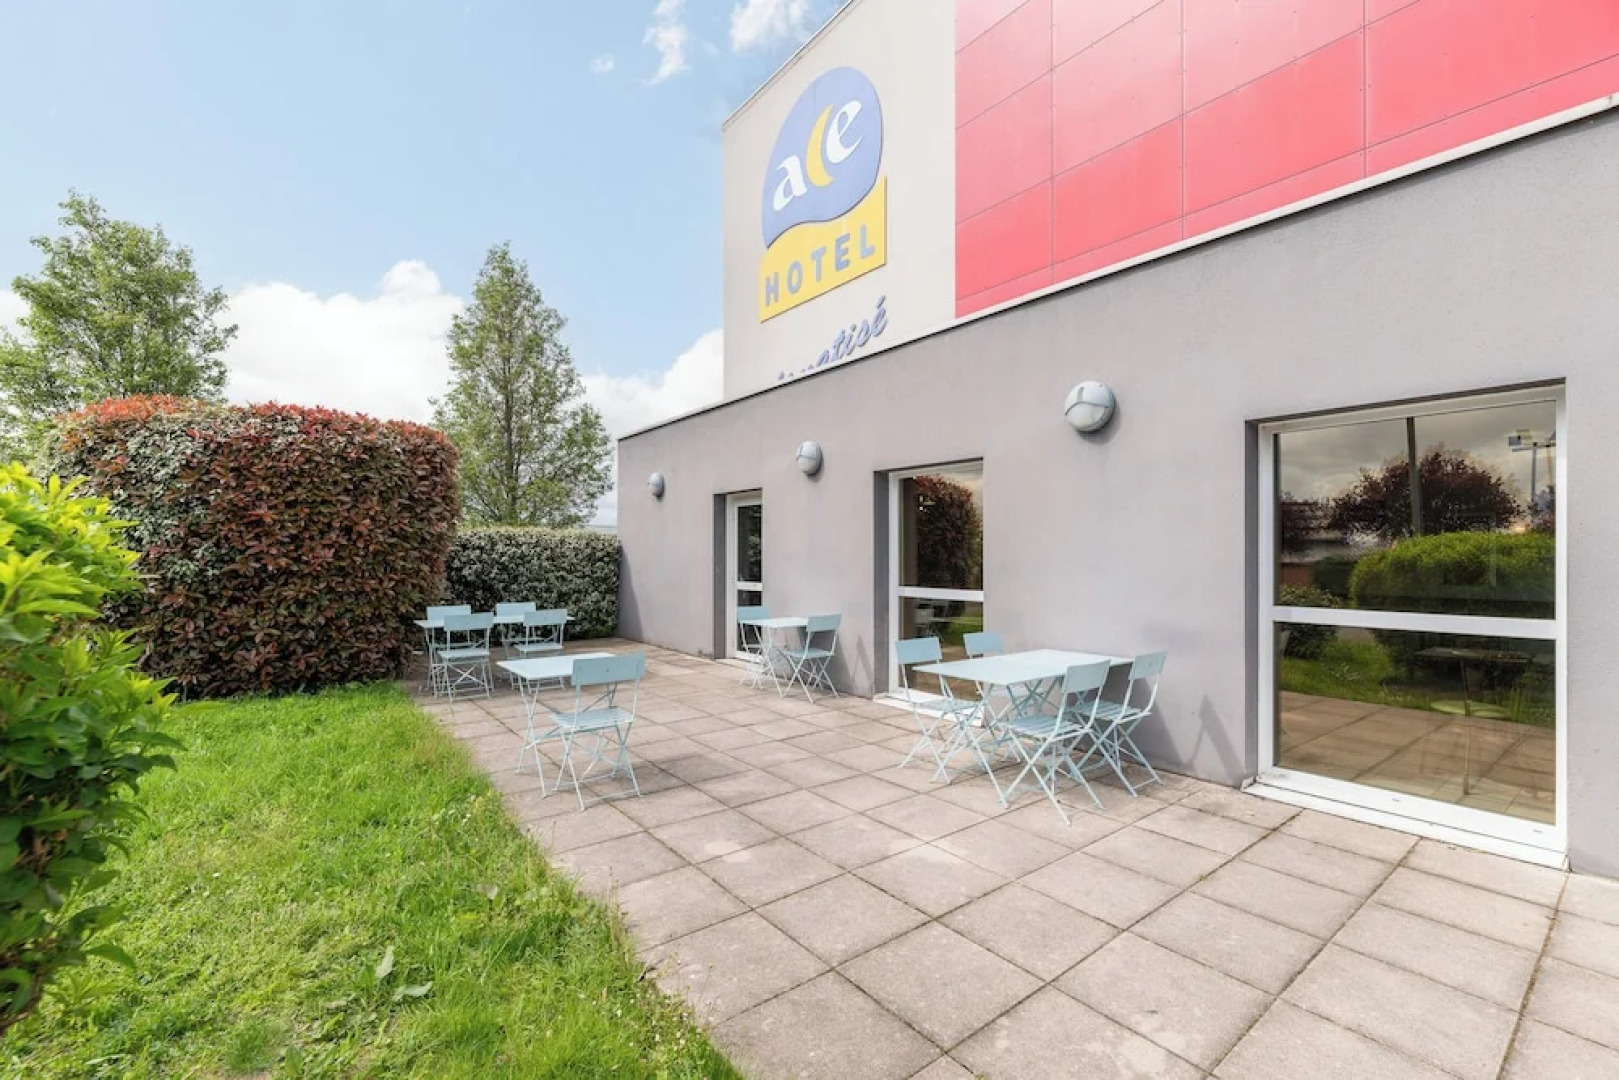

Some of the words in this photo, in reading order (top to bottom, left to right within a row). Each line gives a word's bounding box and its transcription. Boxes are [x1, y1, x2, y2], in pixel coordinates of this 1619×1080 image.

[773, 100, 863, 212] ace
[765, 224, 875, 306] HOTEL
[778, 295, 888, 380] atisé
